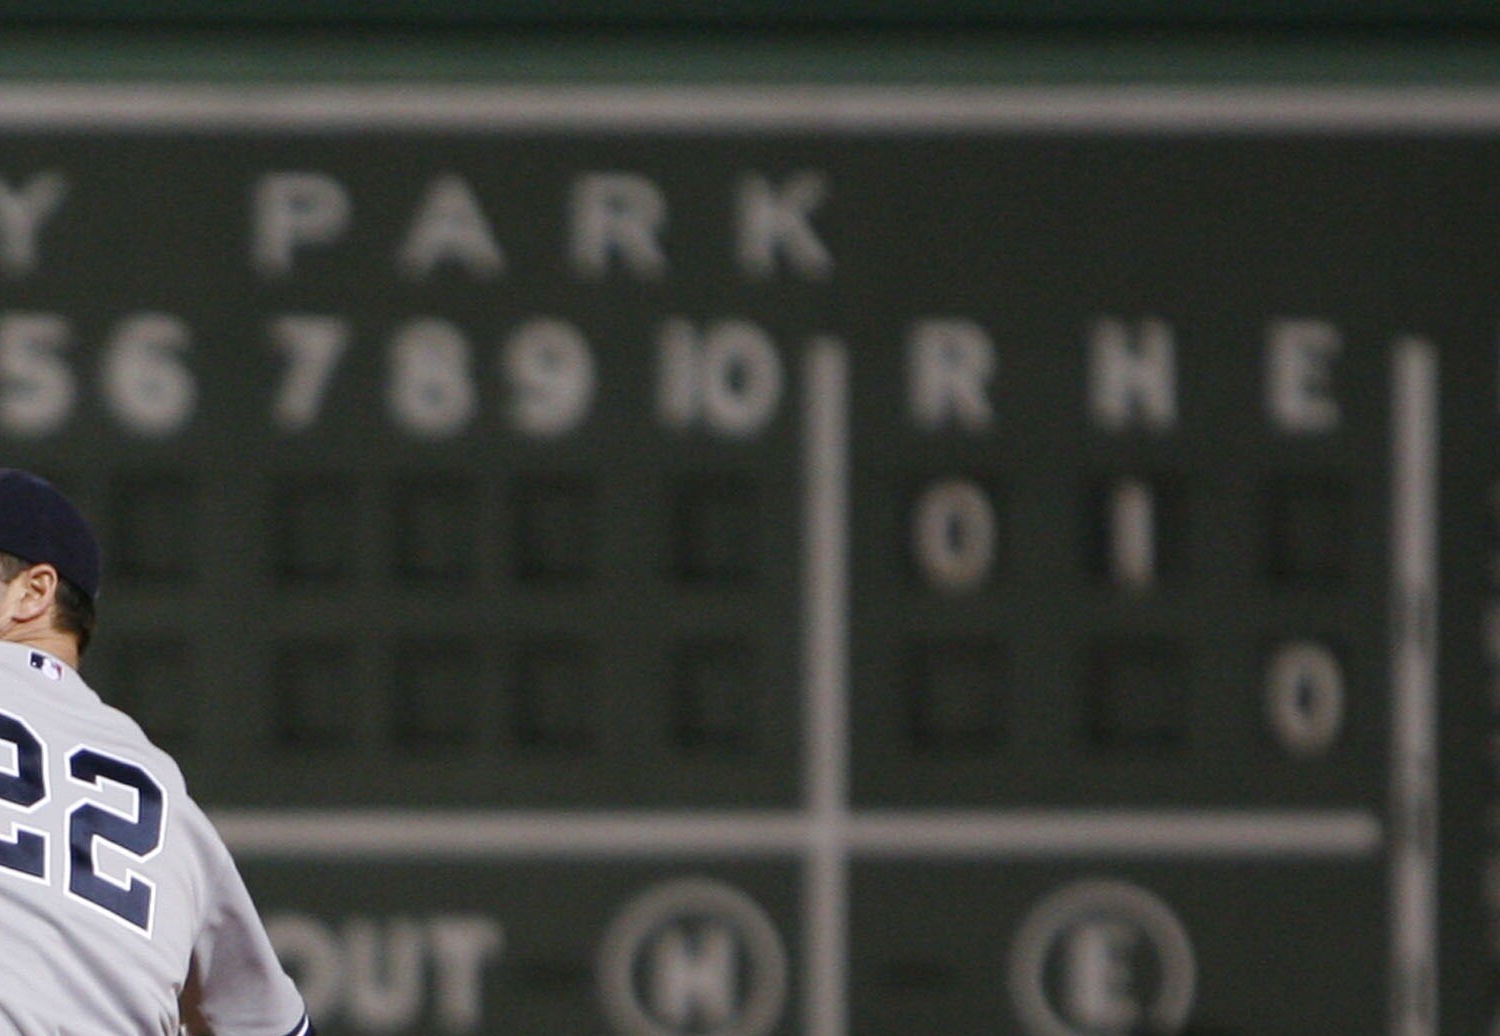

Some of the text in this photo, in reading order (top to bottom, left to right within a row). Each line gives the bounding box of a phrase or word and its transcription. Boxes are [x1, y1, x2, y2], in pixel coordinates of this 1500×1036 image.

[253, 171, 829, 276] PARK
[100, 312, 197, 436] 6
[272, 315, 349, 428] 7
[387, 318, 477, 436] 8
[504, 318, 596, 437] 9
[656, 319, 784, 437] 10
[908, 319, 996, 432] R
[1090, 320, 1177, 429] H
[1267, 320, 1342, 430] E
[915, 480, 996, 590] 0
[1267, 642, 1344, 752] 0
[266, 912, 504, 1033] OUT
